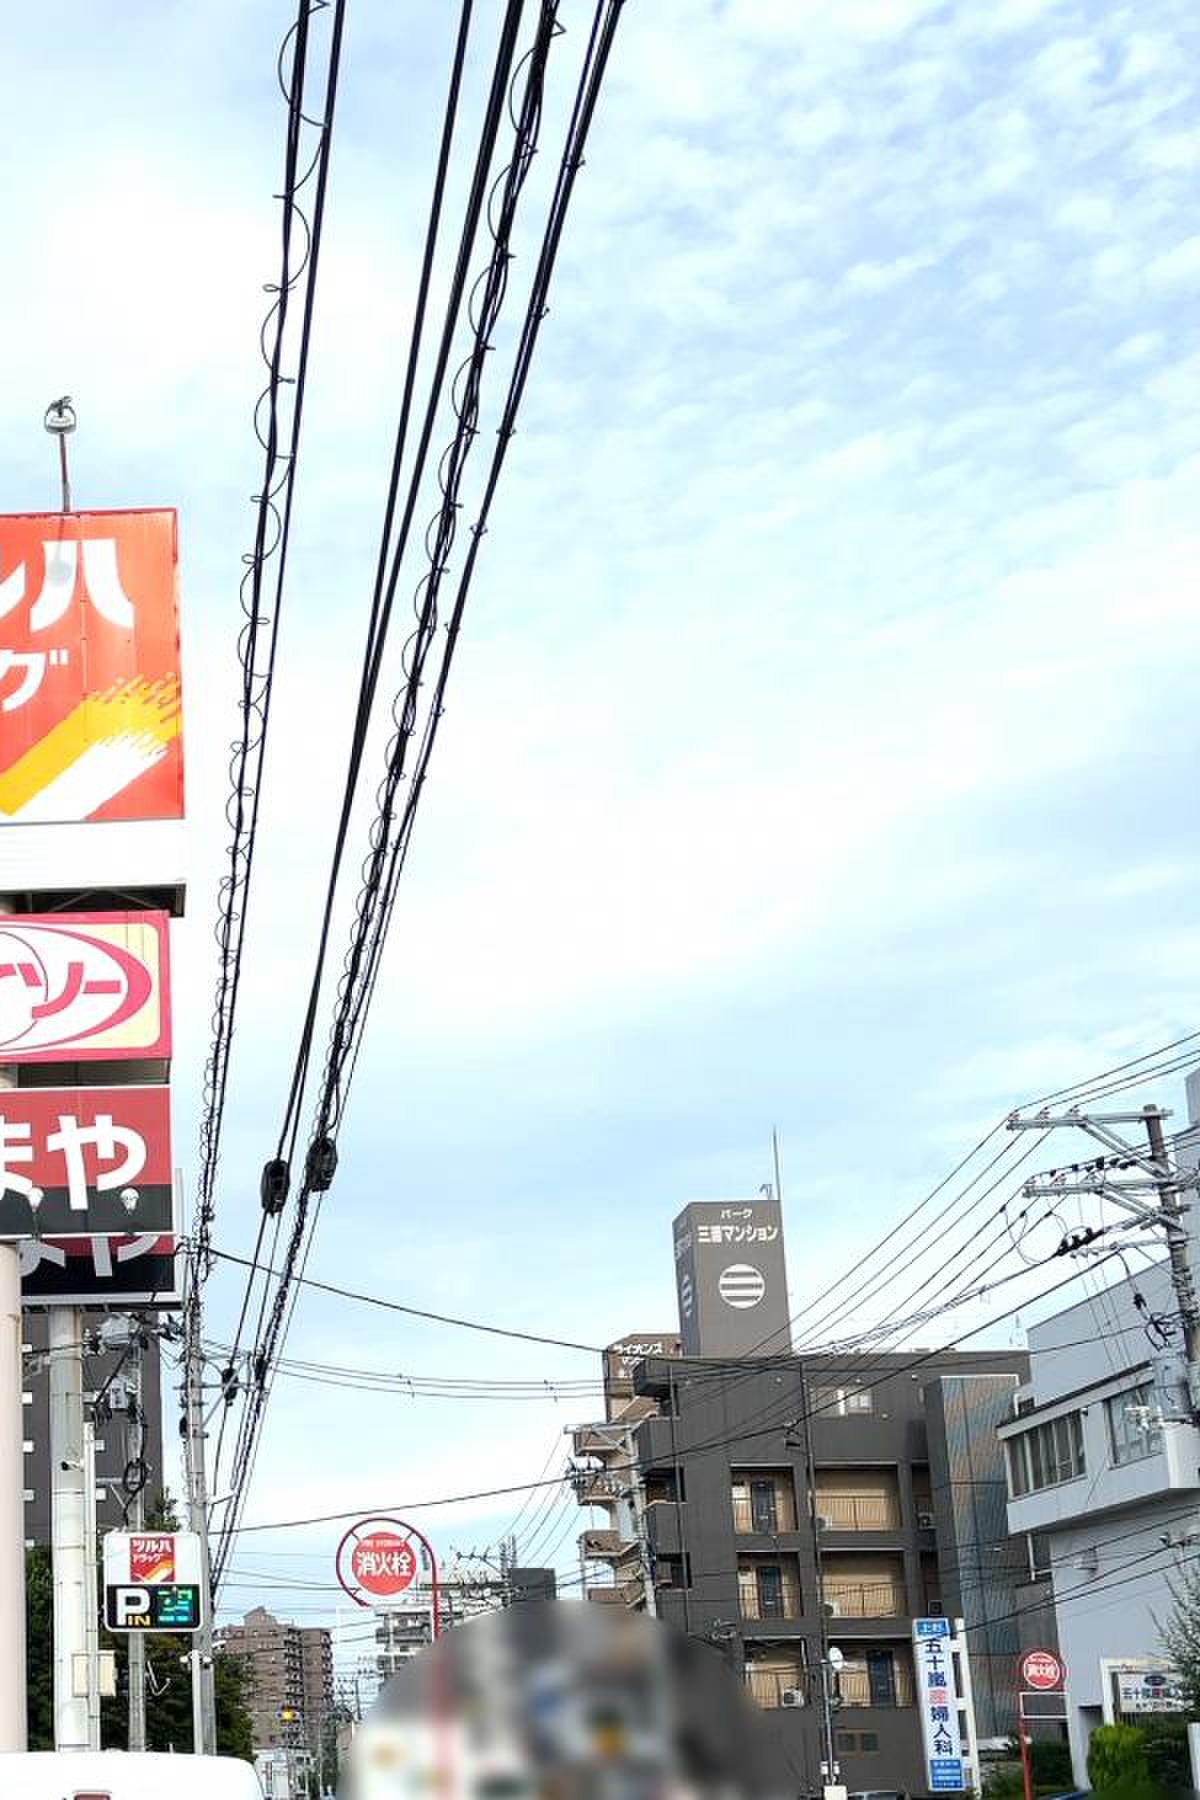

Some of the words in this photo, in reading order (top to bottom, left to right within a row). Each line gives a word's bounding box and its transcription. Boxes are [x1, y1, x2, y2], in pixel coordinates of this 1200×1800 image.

[132, 1539, 172, 1553] ツルハ
[356, 1551, 413, 1577] 消火栓
[116, 1588, 150, 1626] P
[127, 1615, 151, 1626] IN
